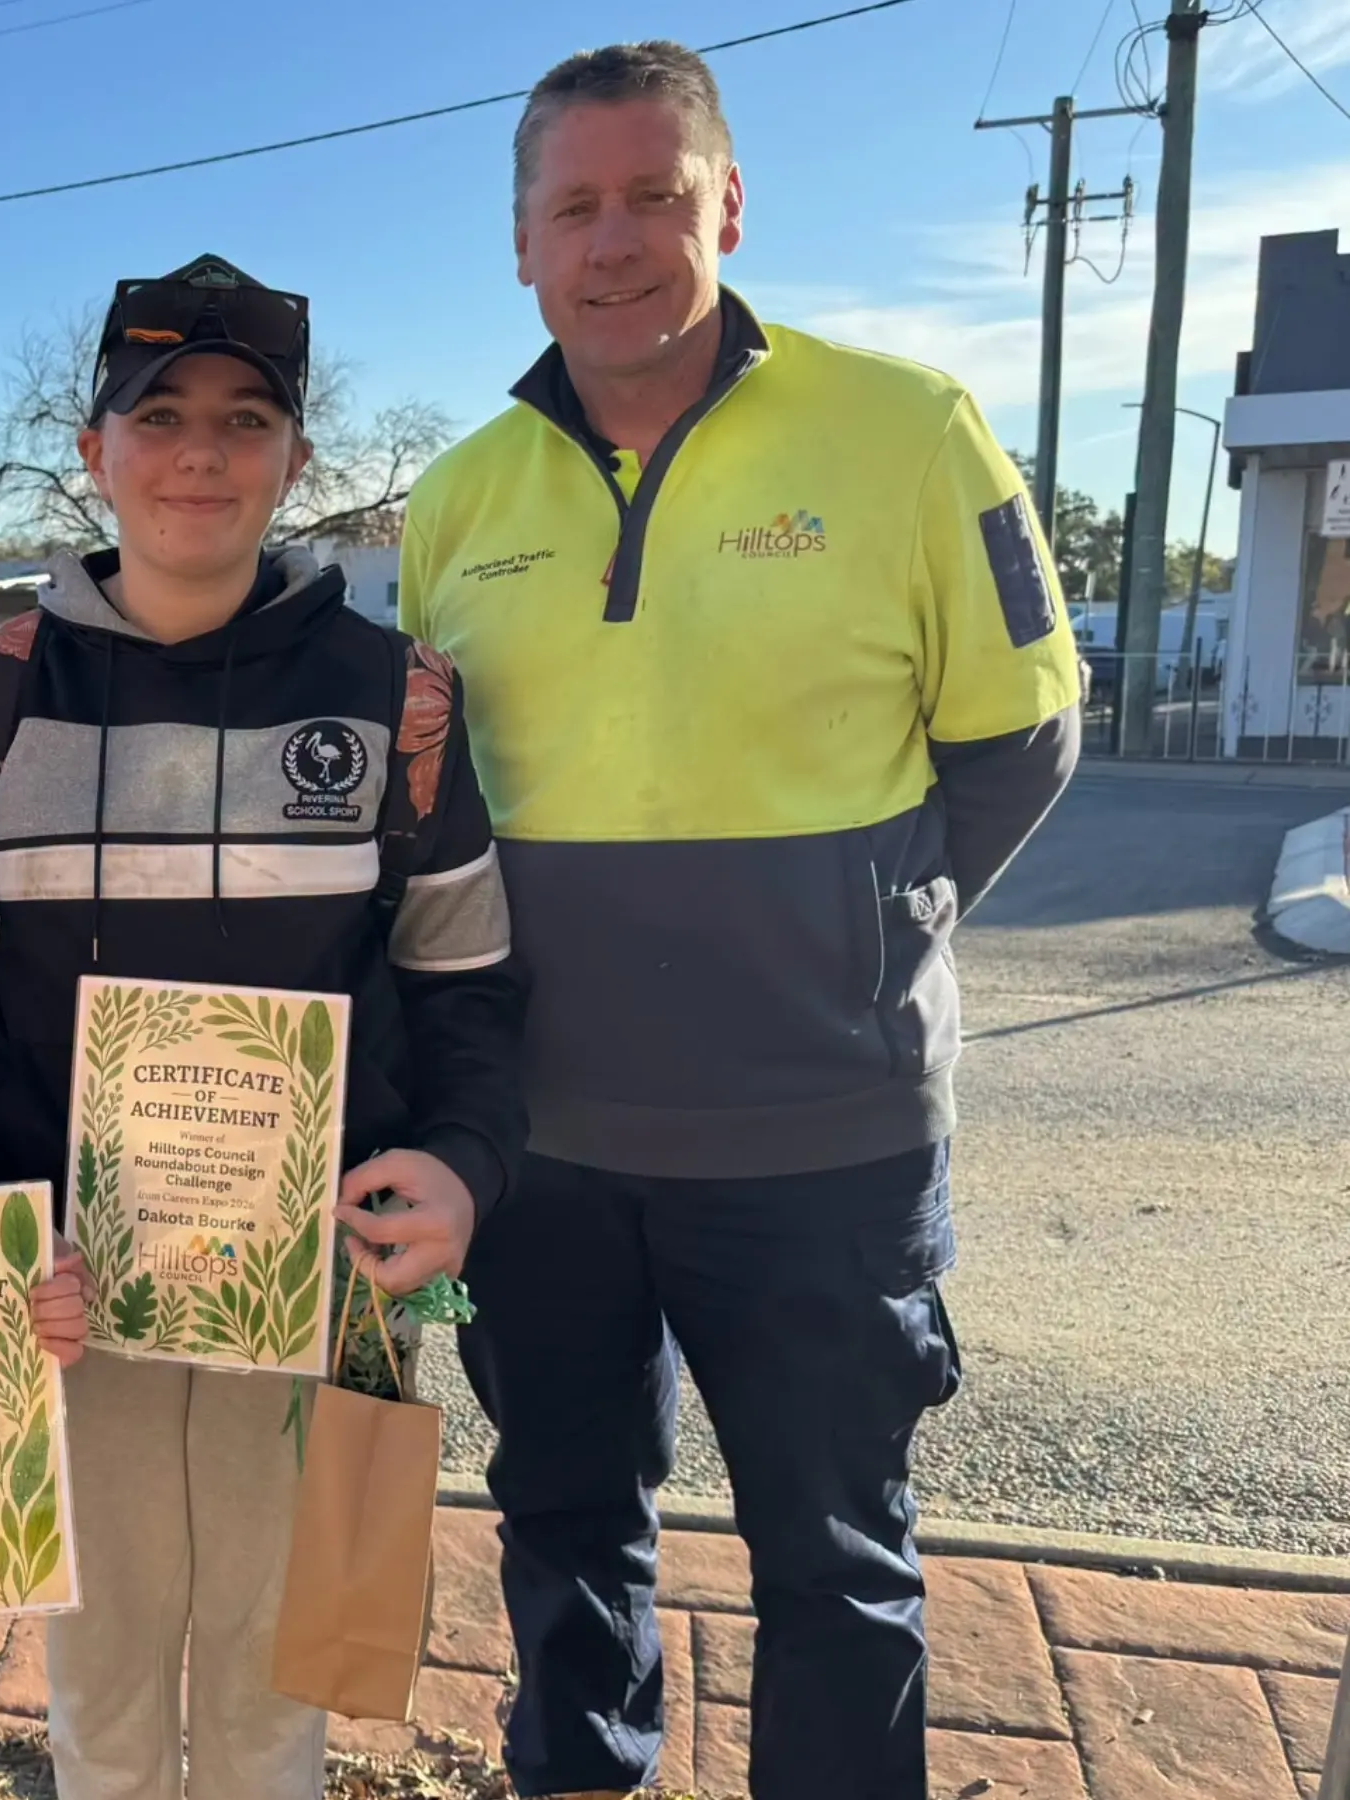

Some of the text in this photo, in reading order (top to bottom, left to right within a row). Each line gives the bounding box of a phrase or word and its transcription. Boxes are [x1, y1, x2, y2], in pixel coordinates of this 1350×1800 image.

[718, 527, 826, 558] Hilltops
[461, 549, 556, 577] Authorised Traffic
[741, 551, 791, 559] COUNCIL
[478, 565, 529, 581] Controller
[302, 794, 345, 803] RIVERINA
[287, 806, 359, 817] SCHOOL SPORT
[133, 1064, 285, 1095] CERTIFICATE
[194, 1089, 217, 1103] OF
[130, 1100, 280, 1129] ACHIEVEMENT
[180, 1130, 226, 1144] Winner of
[148, 1141, 255, 1162] Hilltops Council
[134, 1155, 266, 1181] Roundabout Design
[165, 1174, 233, 1193] Challenge
[137, 1190, 160, 1201] from
[162, 1192, 200, 1204] Careers
[202, 1195, 228, 1208] Expo
[138, 1208, 256, 1232] Dakota Bourke
[138, 1242, 238, 1282] Hilltops
[159, 1270, 203, 1282] COUNCIL
